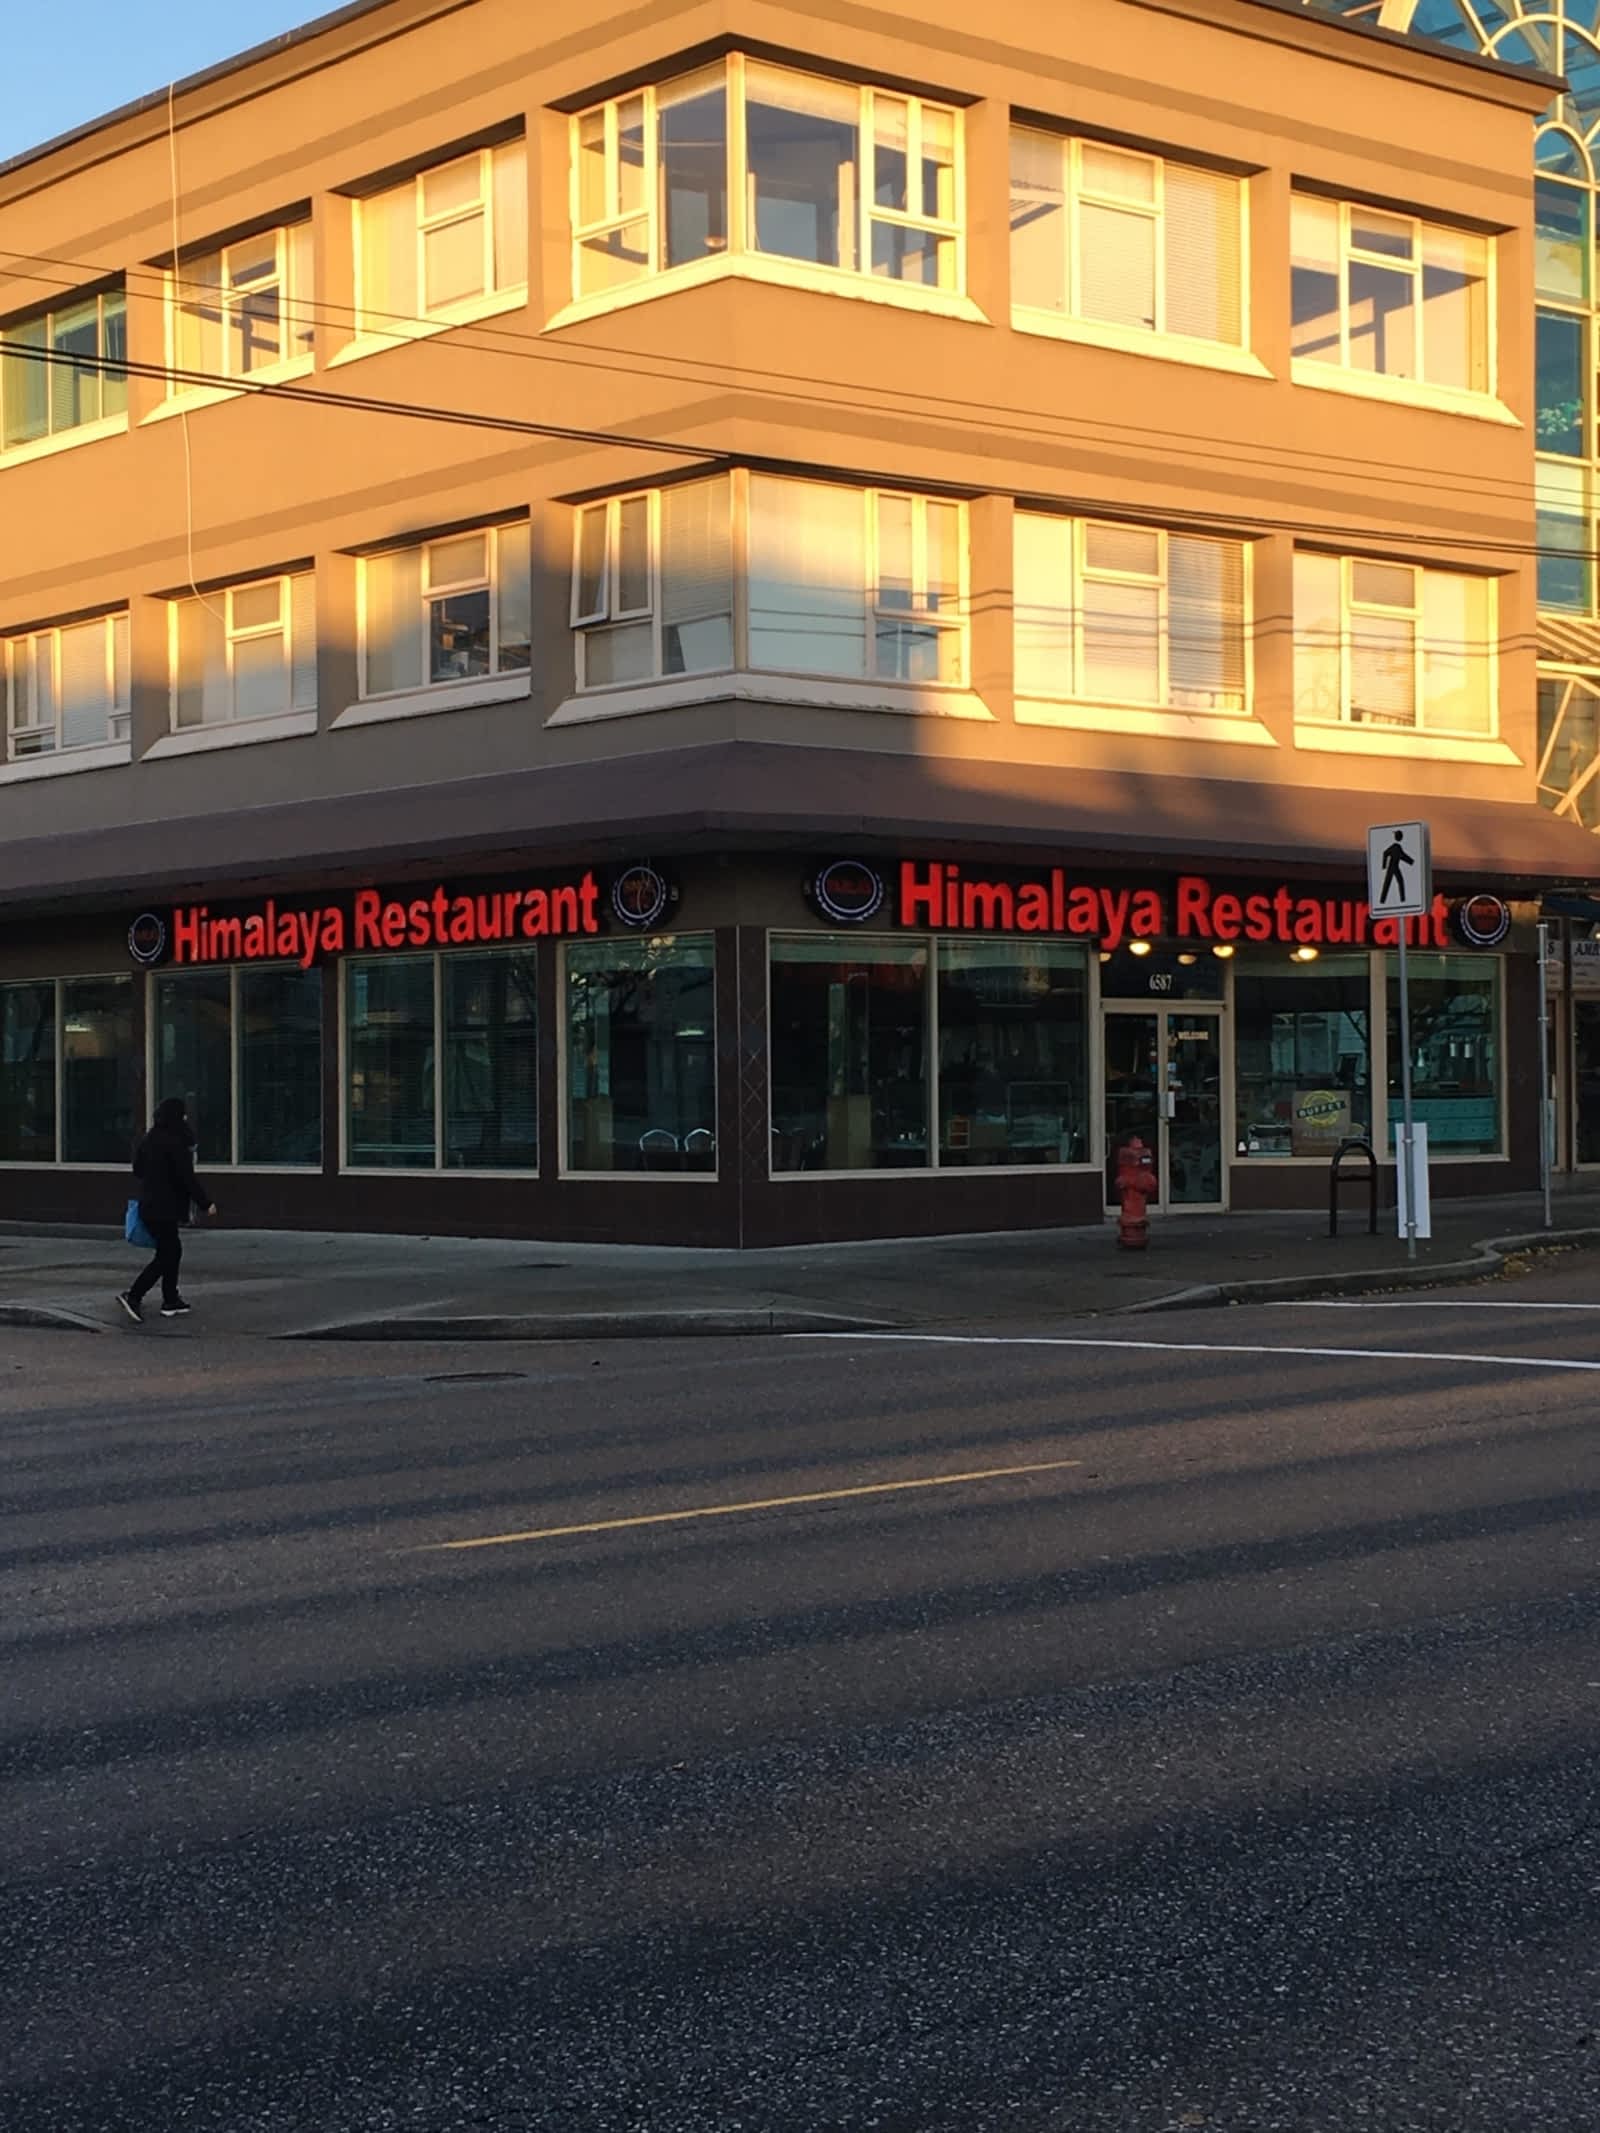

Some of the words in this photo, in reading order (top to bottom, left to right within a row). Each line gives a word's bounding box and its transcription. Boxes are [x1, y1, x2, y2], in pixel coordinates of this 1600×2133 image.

[174, 898, 343, 968] Himalaya
[355, 873, 599, 948] Restaurant
[901, 862, 1161, 950] Himalaya
[1178, 876, 1449, 947] Restaurant
[1148, 973, 1173, 991] 6587
[1298, 1101, 1344, 1118] BUFFET
